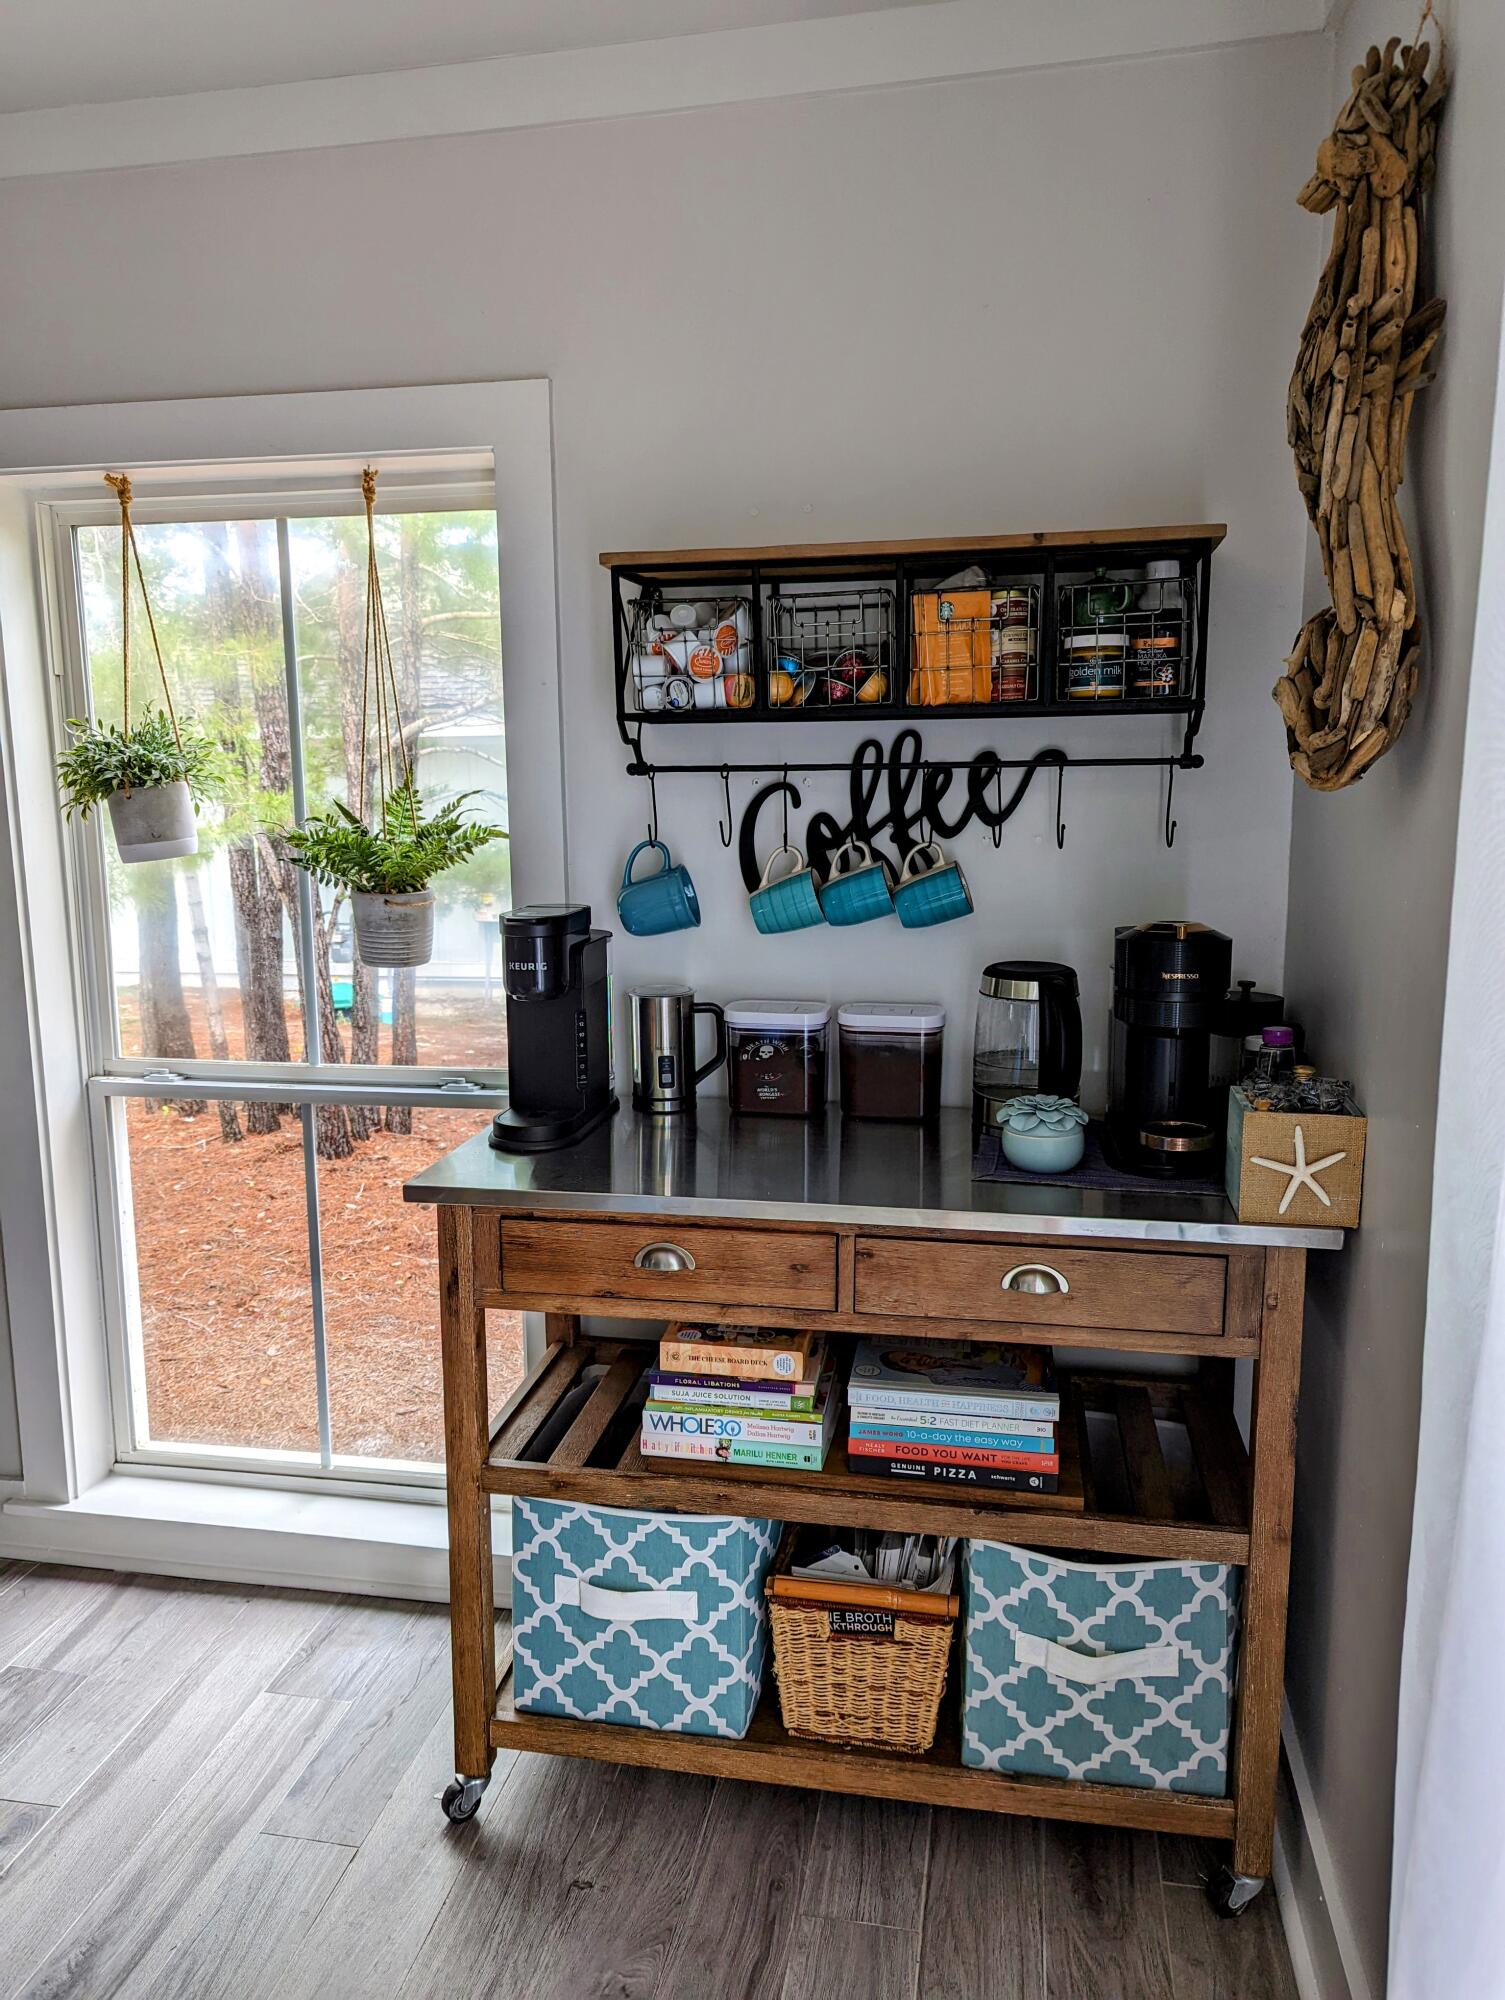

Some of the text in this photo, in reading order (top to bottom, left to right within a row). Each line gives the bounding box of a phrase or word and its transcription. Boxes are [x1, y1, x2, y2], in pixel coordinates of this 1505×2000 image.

[1070, 665, 1122, 679] golden milk
[739, 729, 1068, 894] Coffee
[508, 962, 548, 971] KEURIG
[1162, 972, 1199, 980] NESPRESSO
[702, 1356, 726, 1364] CHEESE
[674, 1378, 702, 1386] FLORAL
[714, 1393, 751, 1401] SOLUTION
[866, 1393, 896, 1404] FOOD,
[900, 1396, 939, 1408] HEALTH
[952, 1400, 1009, 1413] HAPPINESS
[650, 1414, 742, 1437] WHOLE30
[747, 1422, 794, 1434] Melissa Hartwig
[920, 1416, 936, 1426] 5:2
[940, 1417, 958, 1427] FAST
[962, 1419, 979, 1428] DIET
[982, 1421, 1020, 1432] PLANNER
[767, 1431, 790, 1440] Hartwig
[906, 1430, 1024, 1448] 10-a-day the easy way
[734, 1448, 797, 1460] MARILU HENNER
[895, 1445, 998, 1463] FOOD YOU WANT
[890, 1462, 926, 1472] GENUINE
[934, 1467, 976, 1480] PIZZA
[846, 1612, 892, 1624] BROTH
